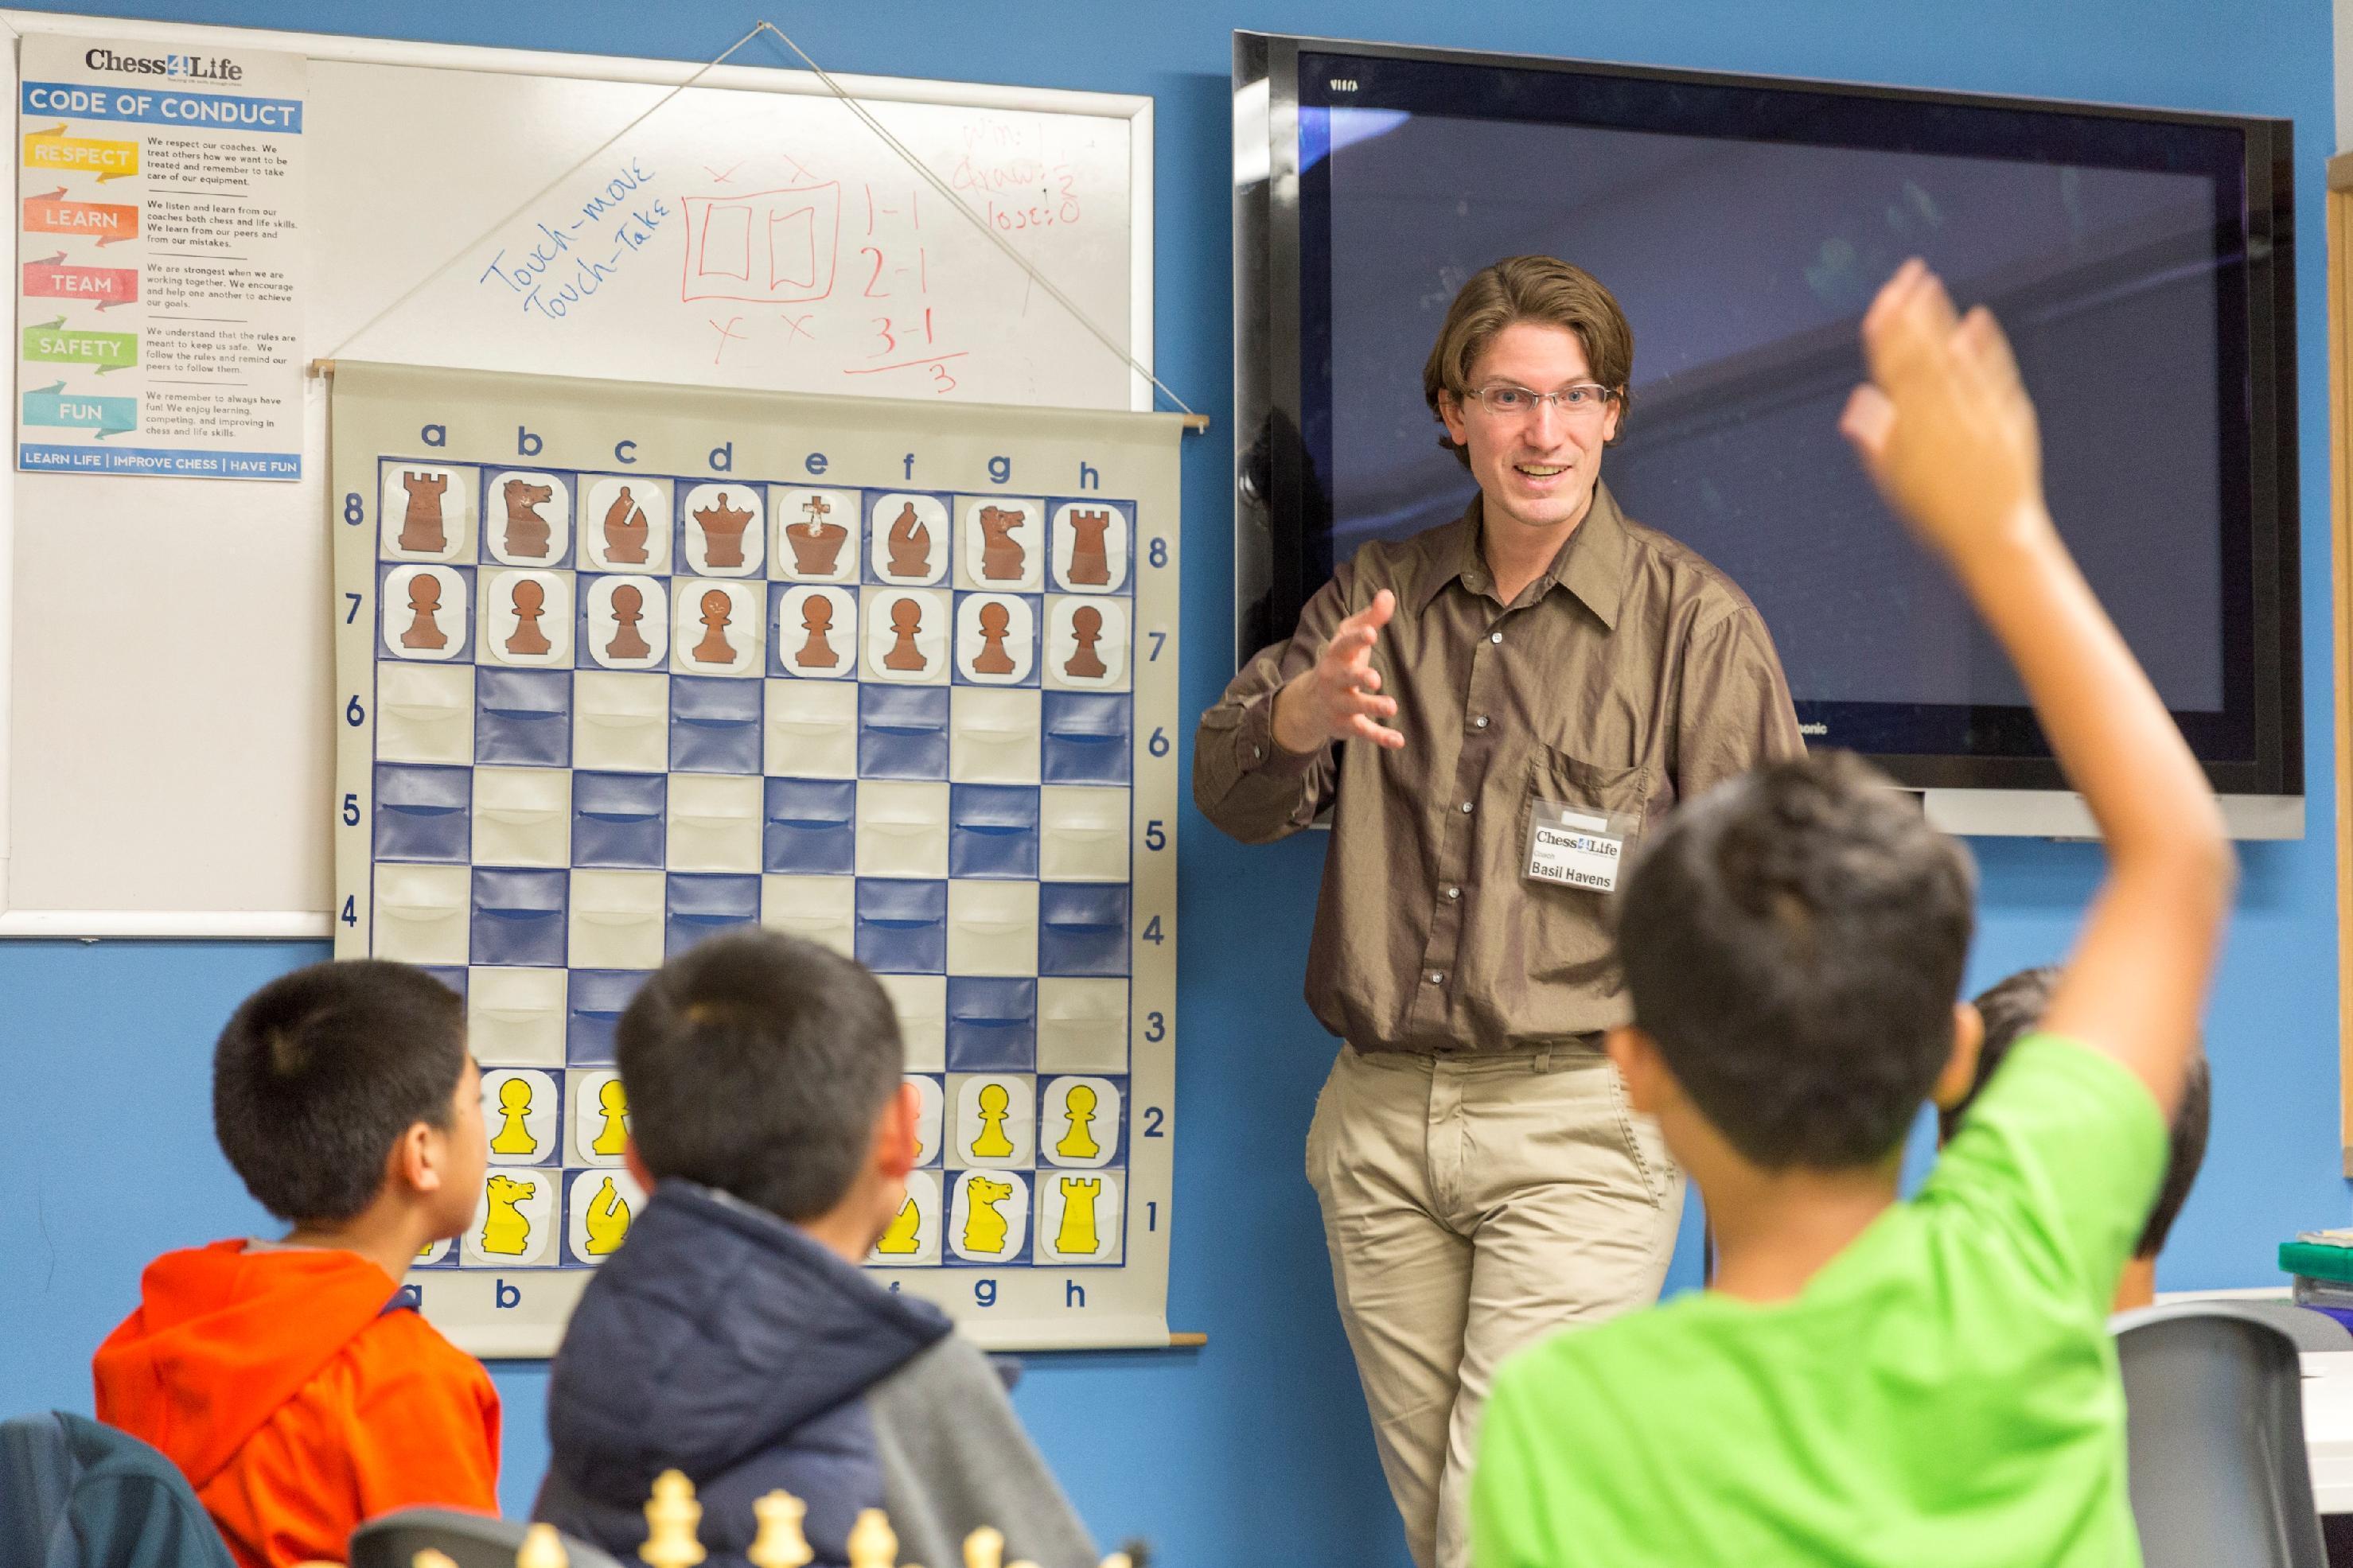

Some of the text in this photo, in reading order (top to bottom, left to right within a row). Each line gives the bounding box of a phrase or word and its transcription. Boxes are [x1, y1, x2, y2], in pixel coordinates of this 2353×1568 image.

[85, 49, 242, 80] Chess4Life
[29, 88, 294, 126] CODE OF CONDUCT
[147, 136, 163, 146] We
[166, 138, 200, 150] respect
[262, 143, 277, 153] We
[35, 144, 130, 166] RESPECT
[147, 149, 169, 158] treat
[172, 150, 200, 159] others
[203, 151, 221, 161] how
[240, 154, 261, 163] want
[276, 156, 288, 165] be
[147, 159, 180, 169] treated
[183, 161, 200, 171] and
[202, 163, 248, 173] remember
[263, 166, 285, 176] take
[169, 172, 180, 181] of
[200, 175, 250, 187] equipment.
[147, 200, 163, 209] We
[166, 201, 190, 211] listen
[193, 203, 210, 212] and
[212, 204, 236, 213] learn
[238, 205, 259, 214] from
[46, 209, 118, 229] LEARN
[146, 212, 298, 228] coaches both chess and life skills.
[147, 223, 162, 232] We
[166, 224, 189, 233] learn
[191, 225, 213, 235] from
[234, 229, 259, 239] peers
[261, 229, 278, 238] and
[147, 235, 169, 243] from
[189, 236, 232, 247] mistakes.
[147, 263, 162, 272] We
[184, 266, 226, 277] strongest
[228, 267, 251, 276] when
[52, 274, 111, 294] TEAM
[147, 274, 293, 292] working together. We encourage
[146, 286, 163, 295] and
[166, 287, 185, 298] help
[208, 289, 242, 298] another
[258, 291, 292, 301] achieve
[164, 298, 190, 309] goals.
[146, 327, 162, 336] We
[166, 328, 215, 337] understand
[219, 330, 236, 339] that
[240, 331, 254, 340] the
[257, 332, 279, 340] rules
[40, 337, 122, 357] SAFETY
[146, 339, 174, 348] meant
[191, 340, 212, 351] keep
[257, 343, 274, 352] We
[146, 350, 173, 359] follow
[177, 351, 191, 360] the
[194, 352, 216, 360] rules
[219, 352, 236, 361] and
[239, 353, 269, 363] remind
[146, 363, 170, 372] peers
[186, 363, 213, 372] follow
[929, 363, 956, 394] 3
[146, 391, 162, 399] We
[165, 391, 210, 401] remember
[228, 394, 257, 405] always
[260, 395, 282, 404] have
[60, 403, 102, 421] FUN
[166, 403, 182, 411] We
[185, 406, 210, 414] enjoy
[146, 426, 170, 434] chess
[173, 426, 190, 435] and
[211, 428, 236, 437] skills.
[199, 416, 216, 425] and
[219, 418, 264, 428] improving
[25, 452, 298, 473] LEARN LIFE IMPROVE CHESS HAVE FUN
[421, 423, 1099, 490] a b c d e f g h
[344, 492, 364, 527] 8
[1149, 537, 1168, 569] 8
[345, 593, 363, 624] 7
[1148, 632, 1167, 662] 7
[346, 695, 365, 727] 6
[1148, 726, 1170, 757] 6
[342, 794, 360, 827] 5
[1145, 820, 1167, 851] 5
[1532, 862, 1611, 887] Basil Havens
[341, 894, 357, 928] 4
[1142, 915, 1164, 946] 4
[1144, 1011, 1166, 1043] 3
[1143, 1107, 1164, 1138] 2
[1146, 1201, 1156, 1232] 1
[496, 1278, 521, 1309] b
[974, 1278, 996, 1307] g
[1065, 1279, 1085, 1308] h
